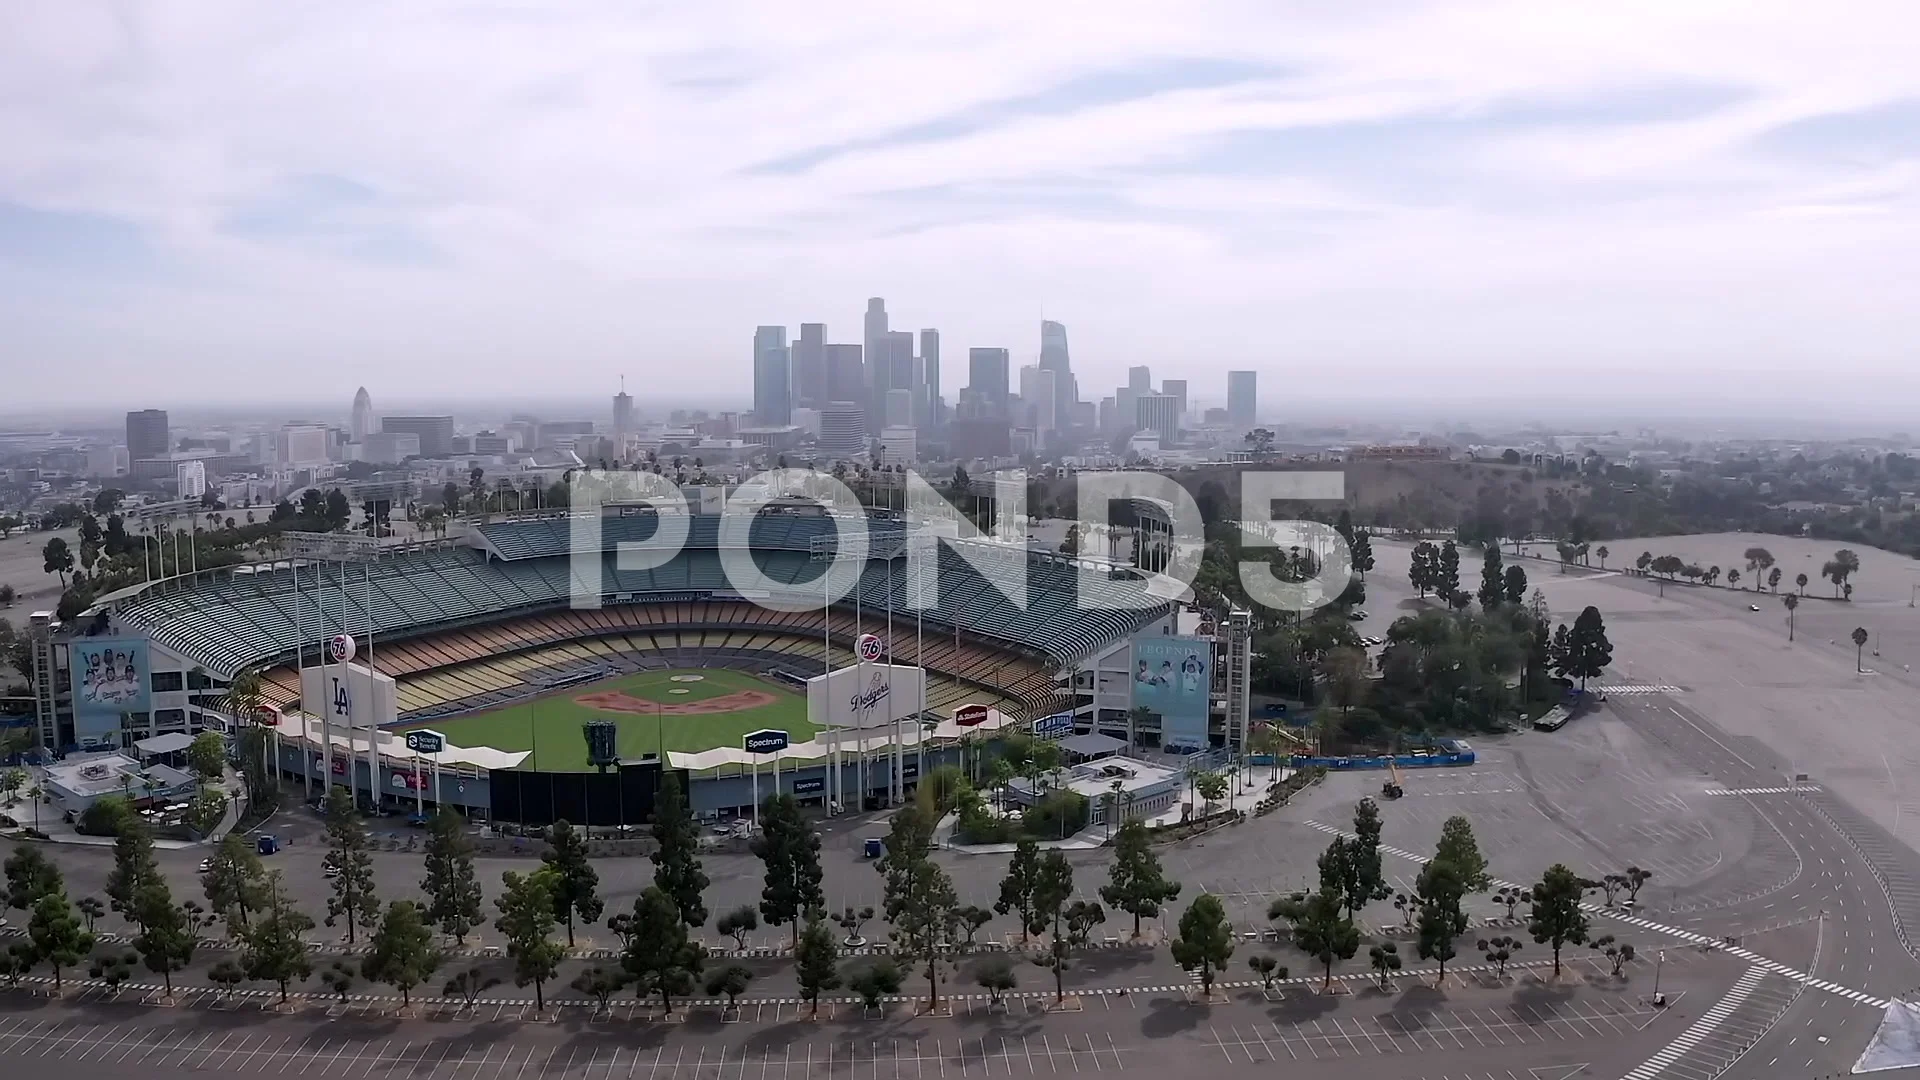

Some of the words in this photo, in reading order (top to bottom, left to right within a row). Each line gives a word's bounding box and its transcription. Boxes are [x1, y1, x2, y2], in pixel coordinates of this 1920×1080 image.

[333, 642, 346, 656] 76
[861, 640, 880, 657] 76
[1139, 644, 1201, 656] LEGENDS
[332, 677, 351, 716] LA
[850, 681, 890, 712] Dodgers
[748, 737, 784, 749] Spectrum
